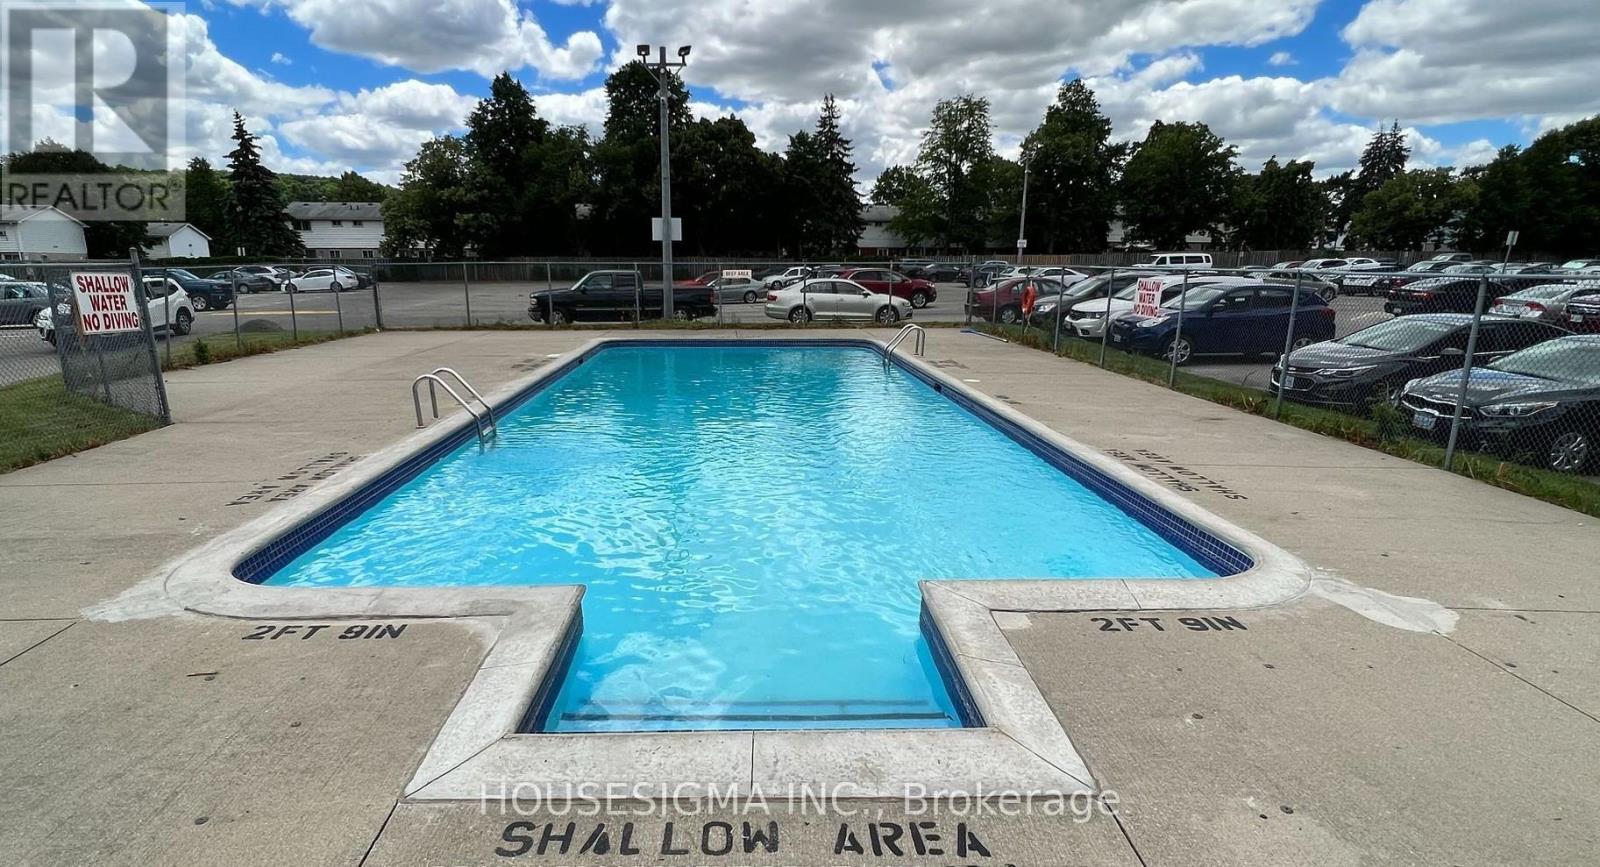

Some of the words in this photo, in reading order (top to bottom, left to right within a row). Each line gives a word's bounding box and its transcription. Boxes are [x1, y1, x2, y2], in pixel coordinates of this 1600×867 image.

[76, 275, 130, 294] SHALLOW
[1137, 280, 1162, 292] SHALLOW
[89, 294, 128, 312] WATER
[1138, 293, 1156, 304] WATER
[1141, 305, 1159, 317] DIVING
[83, 313, 101, 331] NO
[103, 311, 139, 330] DIVING
[242, 625, 329, 640] 2FT
[338, 624, 408, 640] 9IN
[1091, 617, 1165, 632] 2FT
[1177, 616, 1248, 632] 9IN
[495, 821, 779, 857] SHALLOW
[834, 822, 992, 857] AREA
